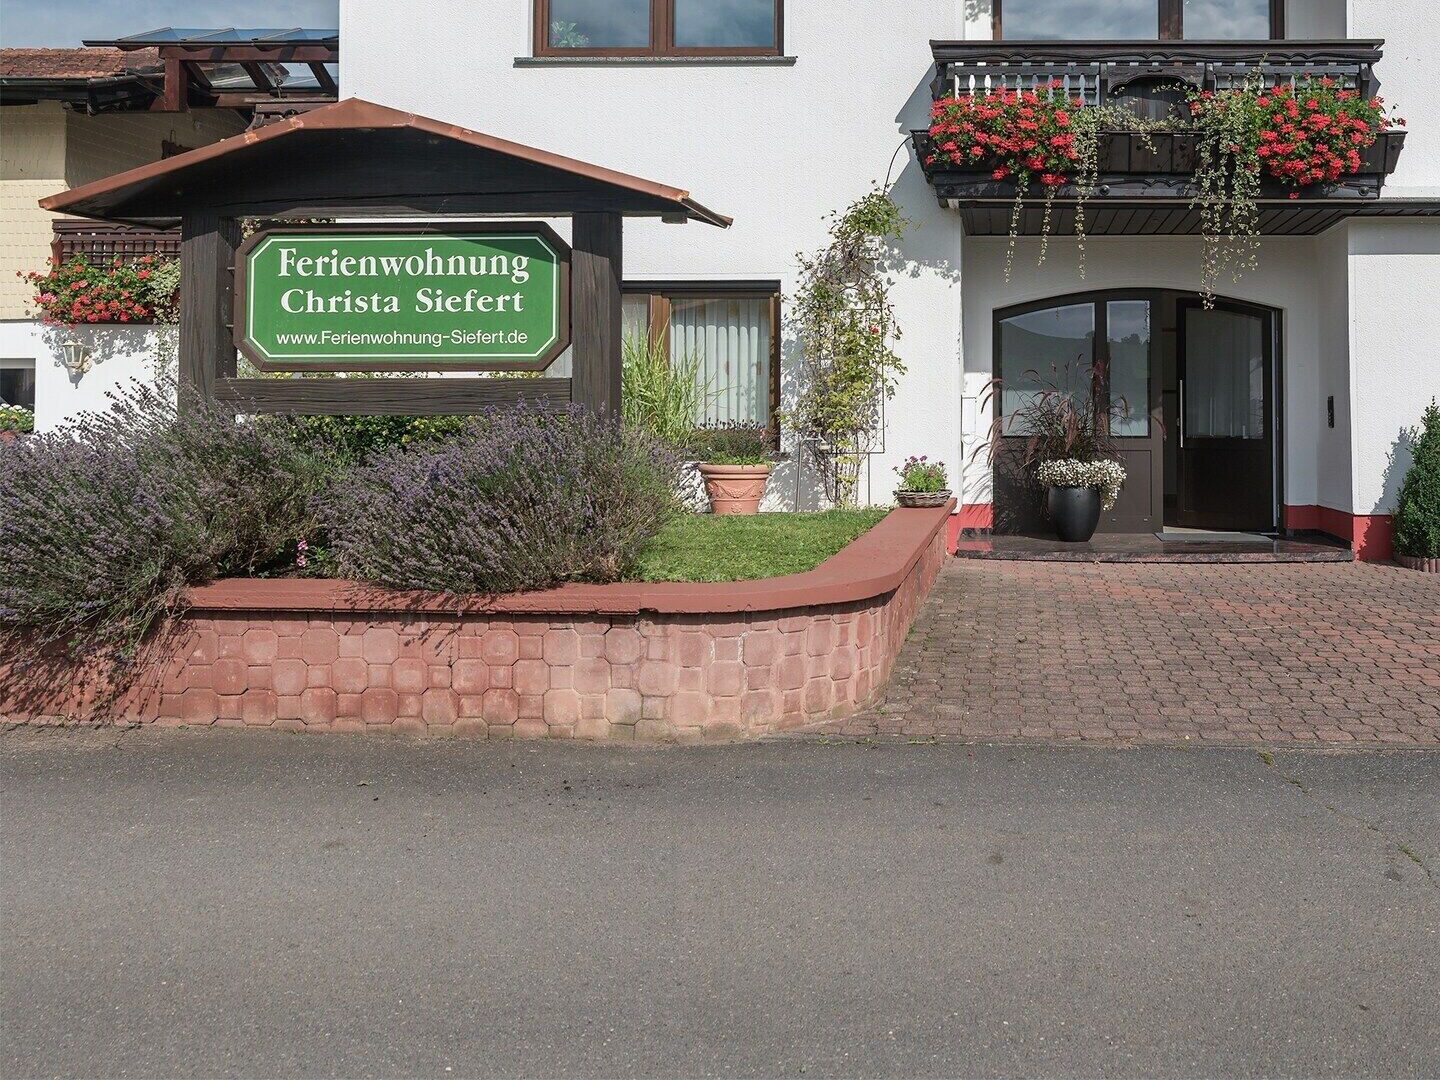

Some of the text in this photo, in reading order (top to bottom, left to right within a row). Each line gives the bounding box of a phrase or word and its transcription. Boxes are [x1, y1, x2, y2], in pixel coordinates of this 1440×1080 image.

[277, 247, 530, 283] Ferienwohnung
[280, 287, 524, 314] Christa Siefert
[276, 329, 528, 347] www.Ferienwohnung-Siefert.de
